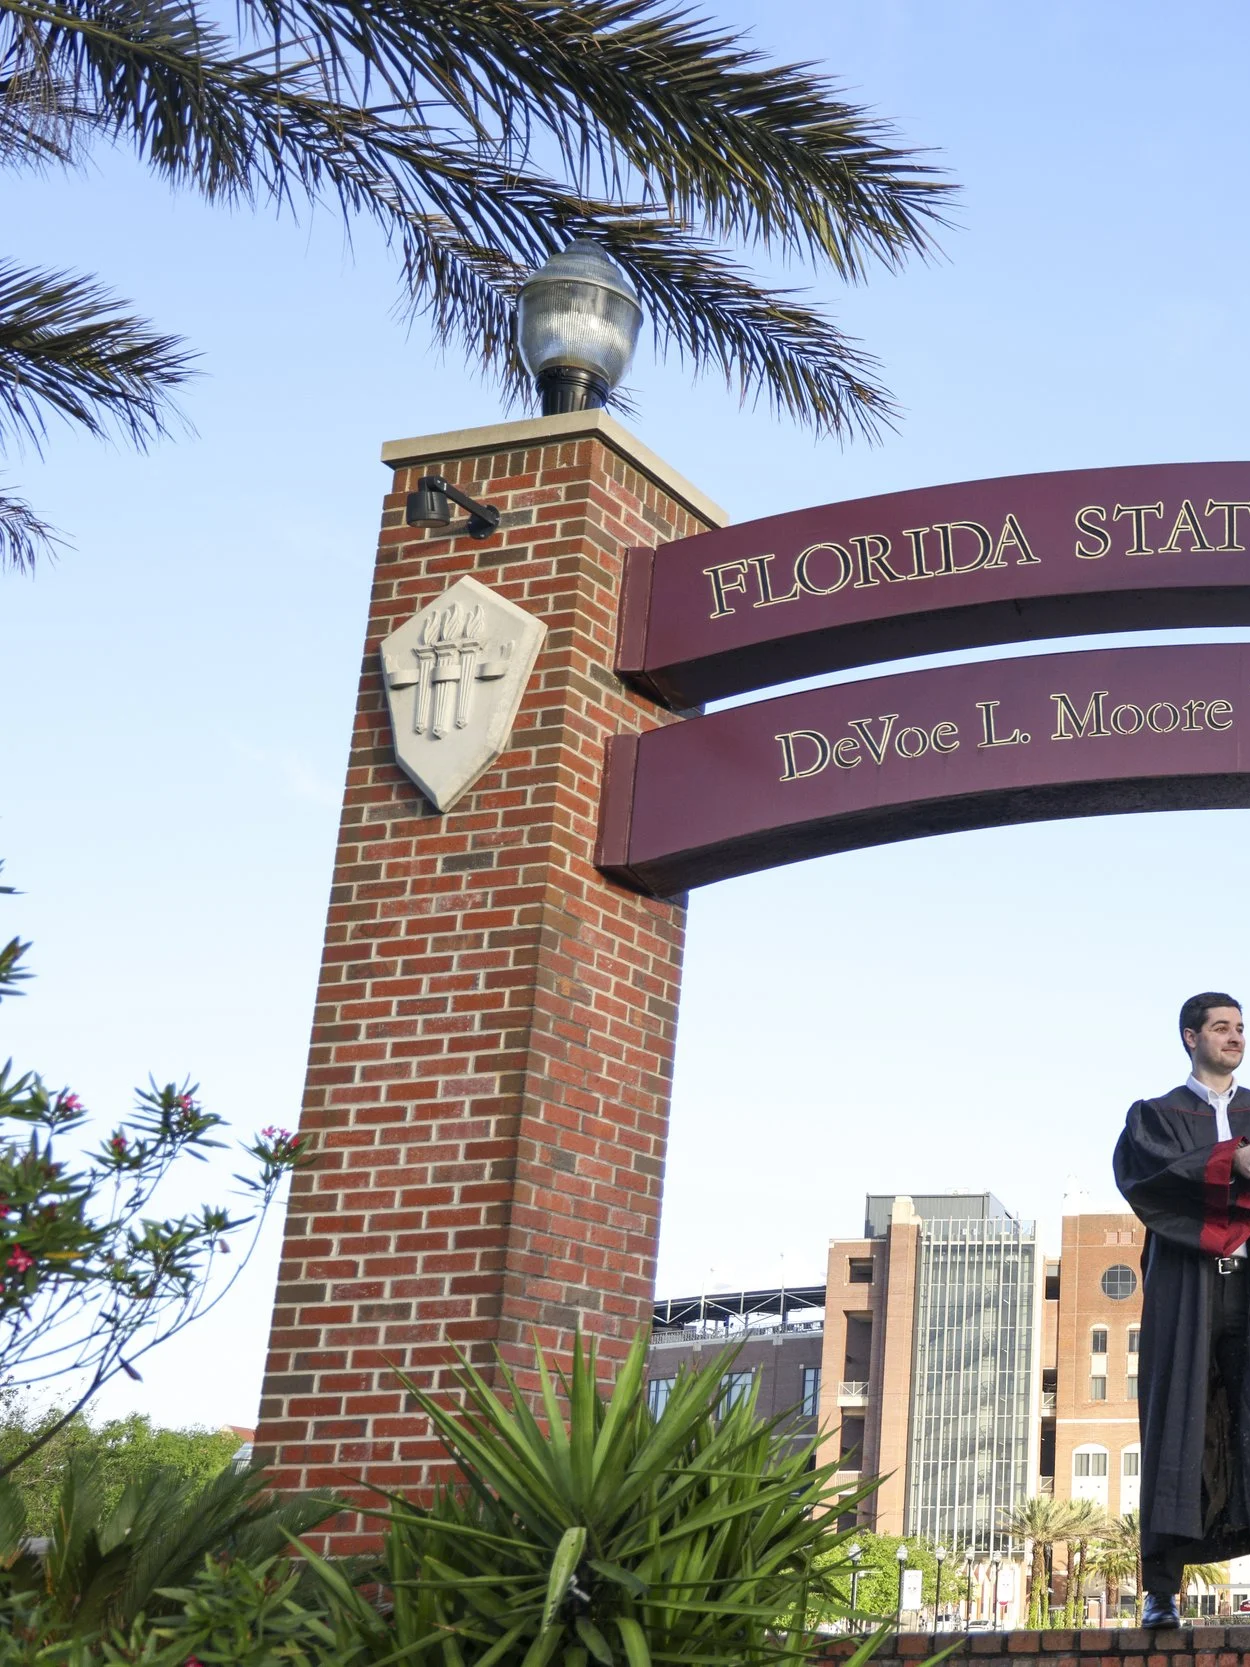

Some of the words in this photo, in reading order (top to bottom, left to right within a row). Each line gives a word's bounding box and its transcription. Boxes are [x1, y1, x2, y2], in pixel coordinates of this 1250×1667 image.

[703, 513, 1041, 619] FLORIDA
[774, 714, 960, 782] DeVoe
[976, 700, 1031, 748] L.
[1050, 690, 1234, 740] Moore
